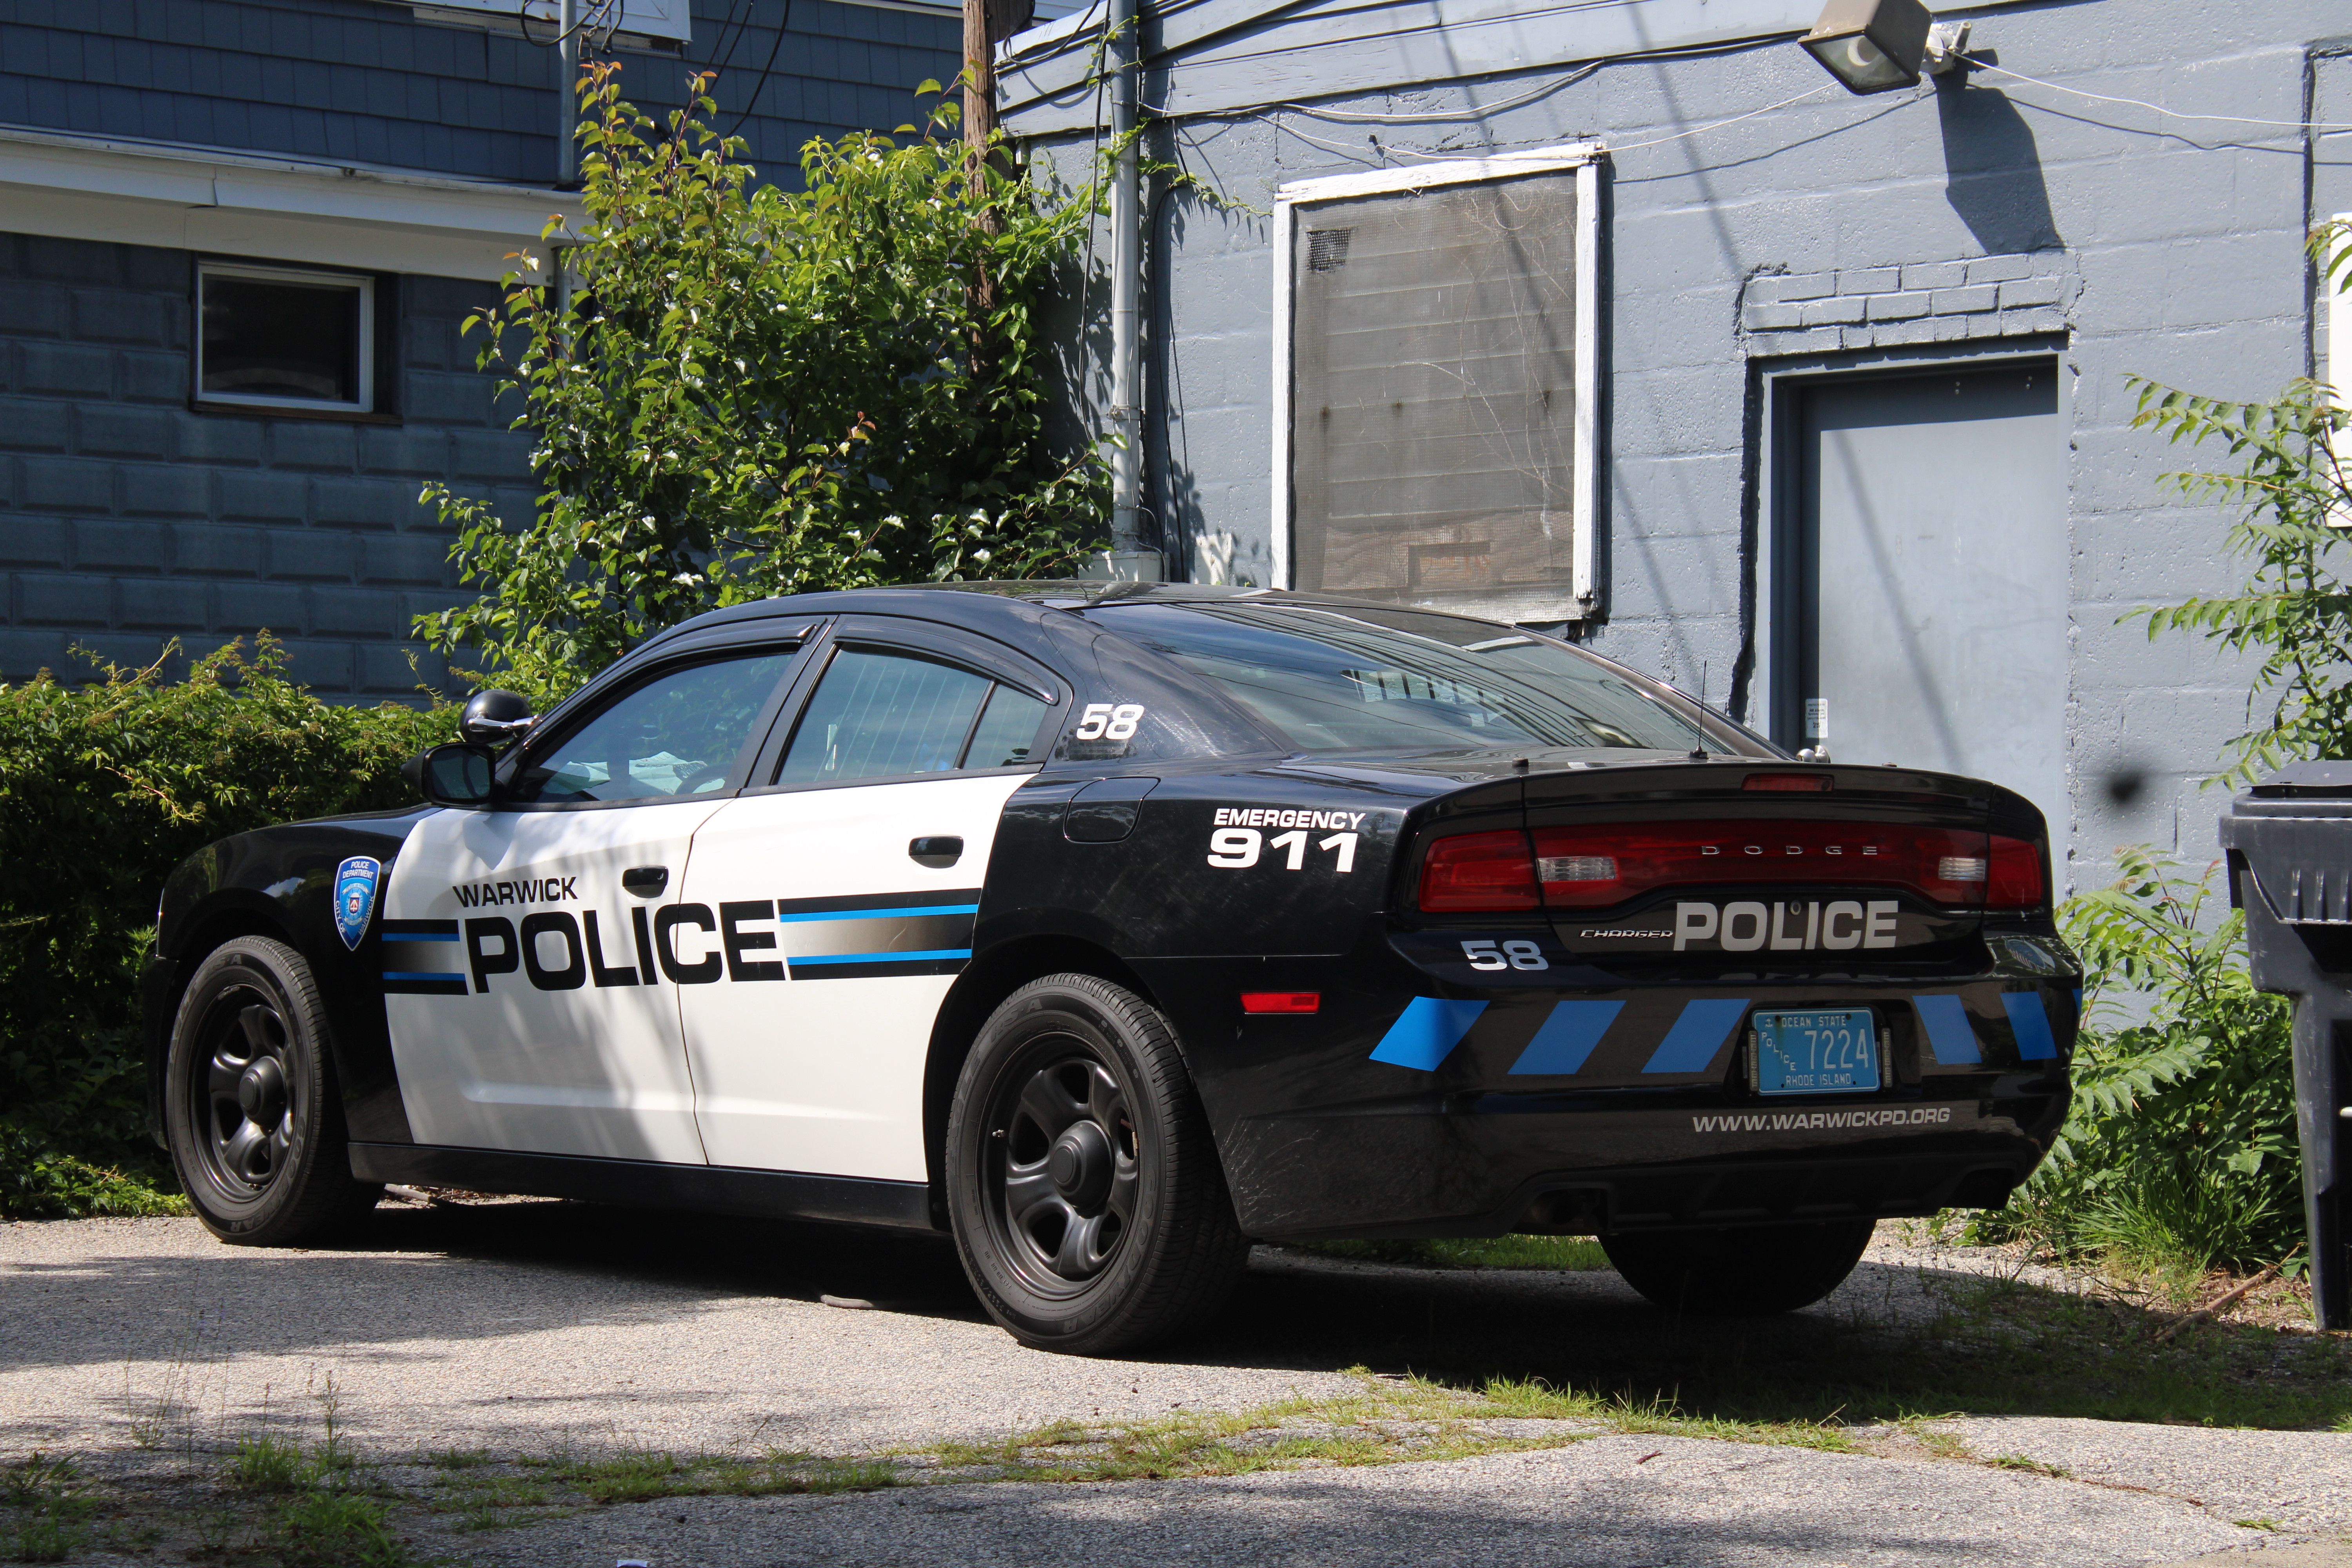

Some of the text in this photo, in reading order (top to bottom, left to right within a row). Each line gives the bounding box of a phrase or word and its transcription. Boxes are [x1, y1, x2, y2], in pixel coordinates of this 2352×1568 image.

[1076, 704, 1145, 740] 58
[1214, 808, 1366, 829] EMERGENCY
[350, 861, 370, 869] POLICE
[1207, 828, 1358, 873] 911
[1702, 846, 1878, 855] DODGE
[342, 869, 374, 879] DEPARTMENT
[452, 877, 578, 908] WARWICK
[339, 923, 346, 933] OF
[358, 895, 374, 935] WARWICK
[1673, 900, 1898, 951] POLICE
[465, 900, 786, 994] POLICE
[1580, 929, 1673, 938] CHARGER
[1460, 940, 1549, 971] 58
[1782, 1016, 1846, 1027] OCEAN STATE
[1761, 1031, 1796, 1071] POLICE
[1804, 1028, 1869, 1070] 7224
[1786, 1073, 1851, 1086] RHODE ISLAND
[1693, 1107, 1951, 1132] WWW.WARWICKPD.ORG
